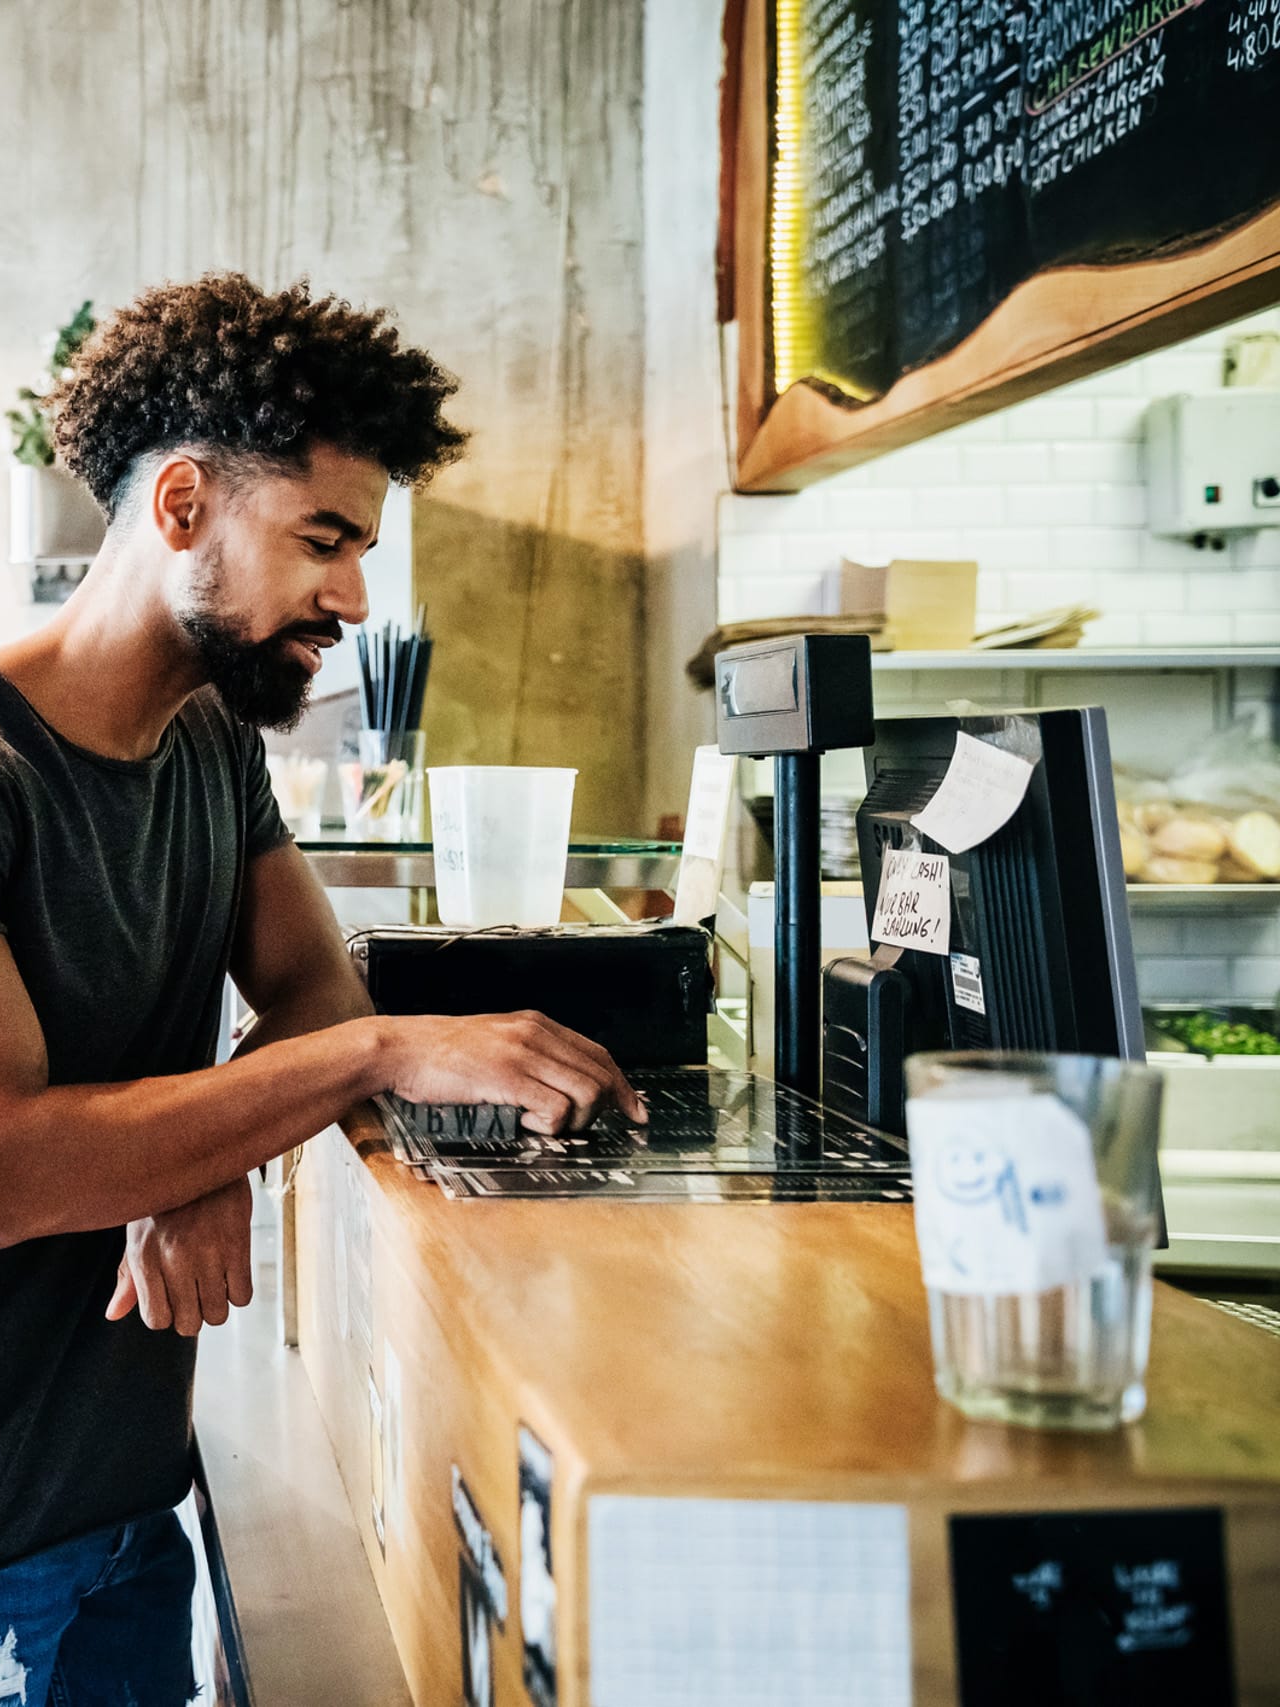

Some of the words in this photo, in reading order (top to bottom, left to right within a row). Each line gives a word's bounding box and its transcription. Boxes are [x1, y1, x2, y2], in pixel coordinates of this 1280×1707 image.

[1226, 23, 1270, 72] 4,80
[1061, 103, 1142, 173] CHICKEN
[897, 890, 920, 916] BAR
